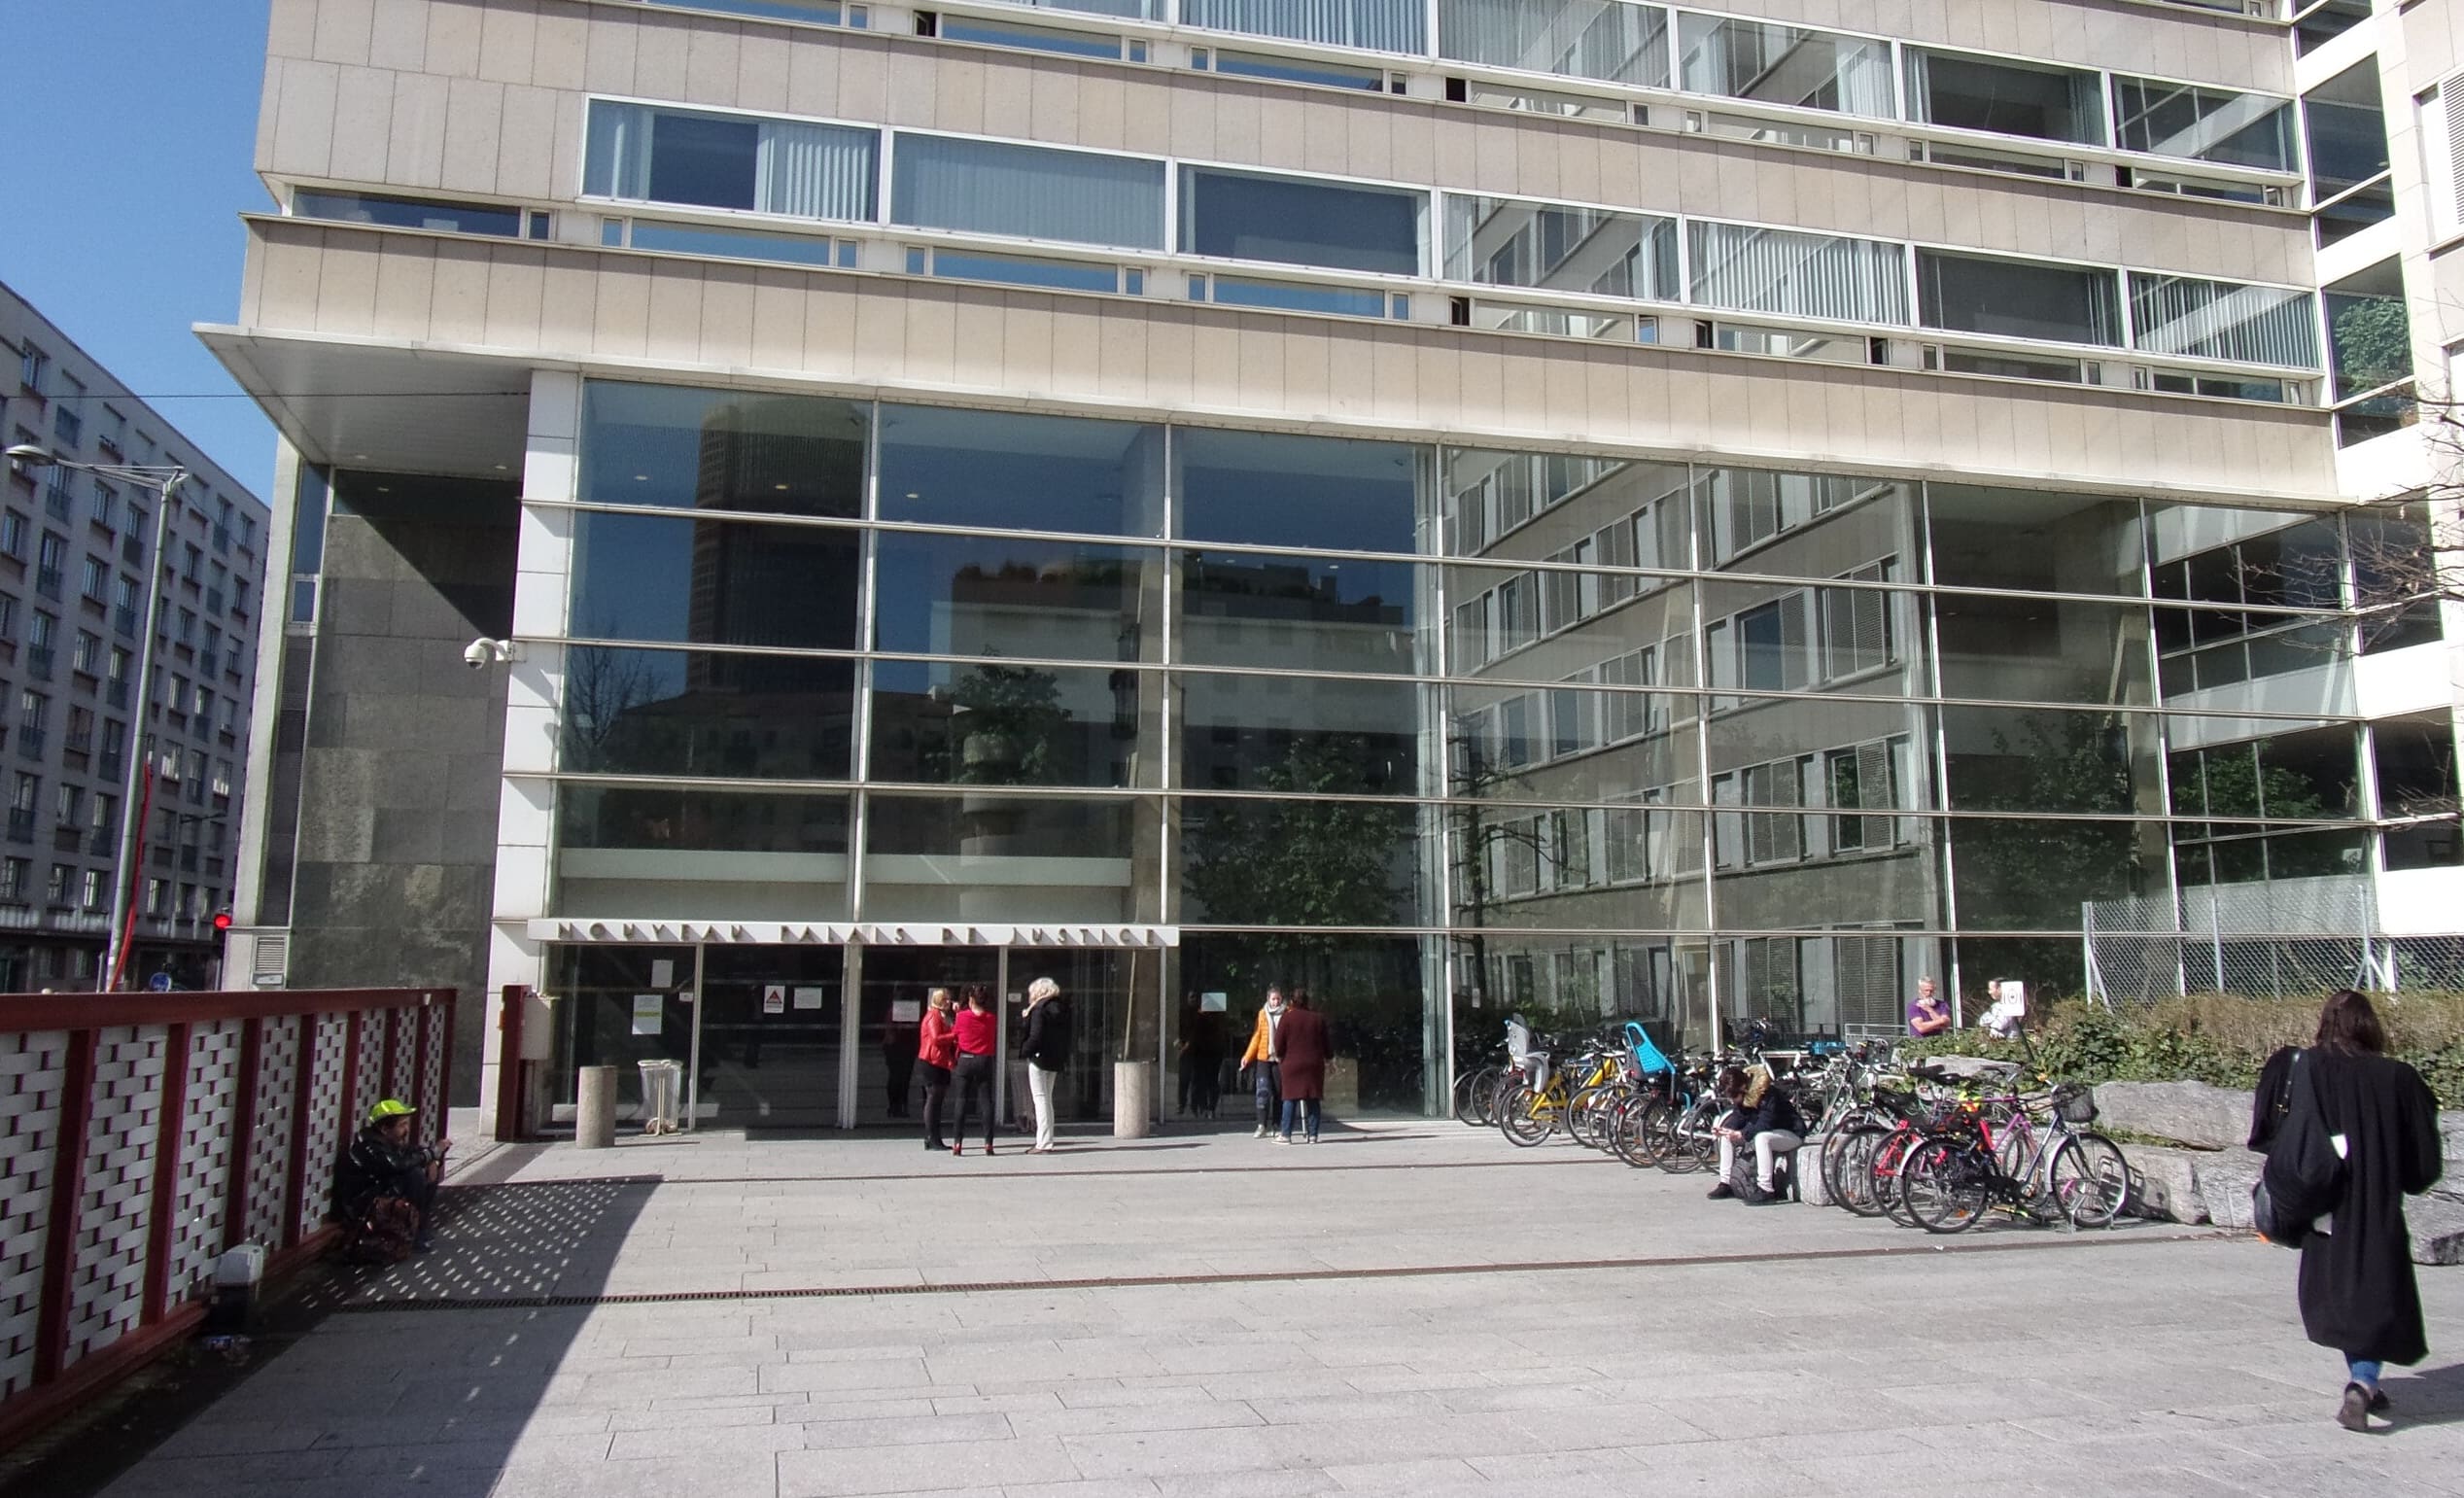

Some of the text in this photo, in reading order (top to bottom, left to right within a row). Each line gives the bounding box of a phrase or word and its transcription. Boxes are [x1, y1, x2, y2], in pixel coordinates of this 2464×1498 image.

[558, 922, 1155, 945] NOUVEAU PALAIS DE JUSTICE
